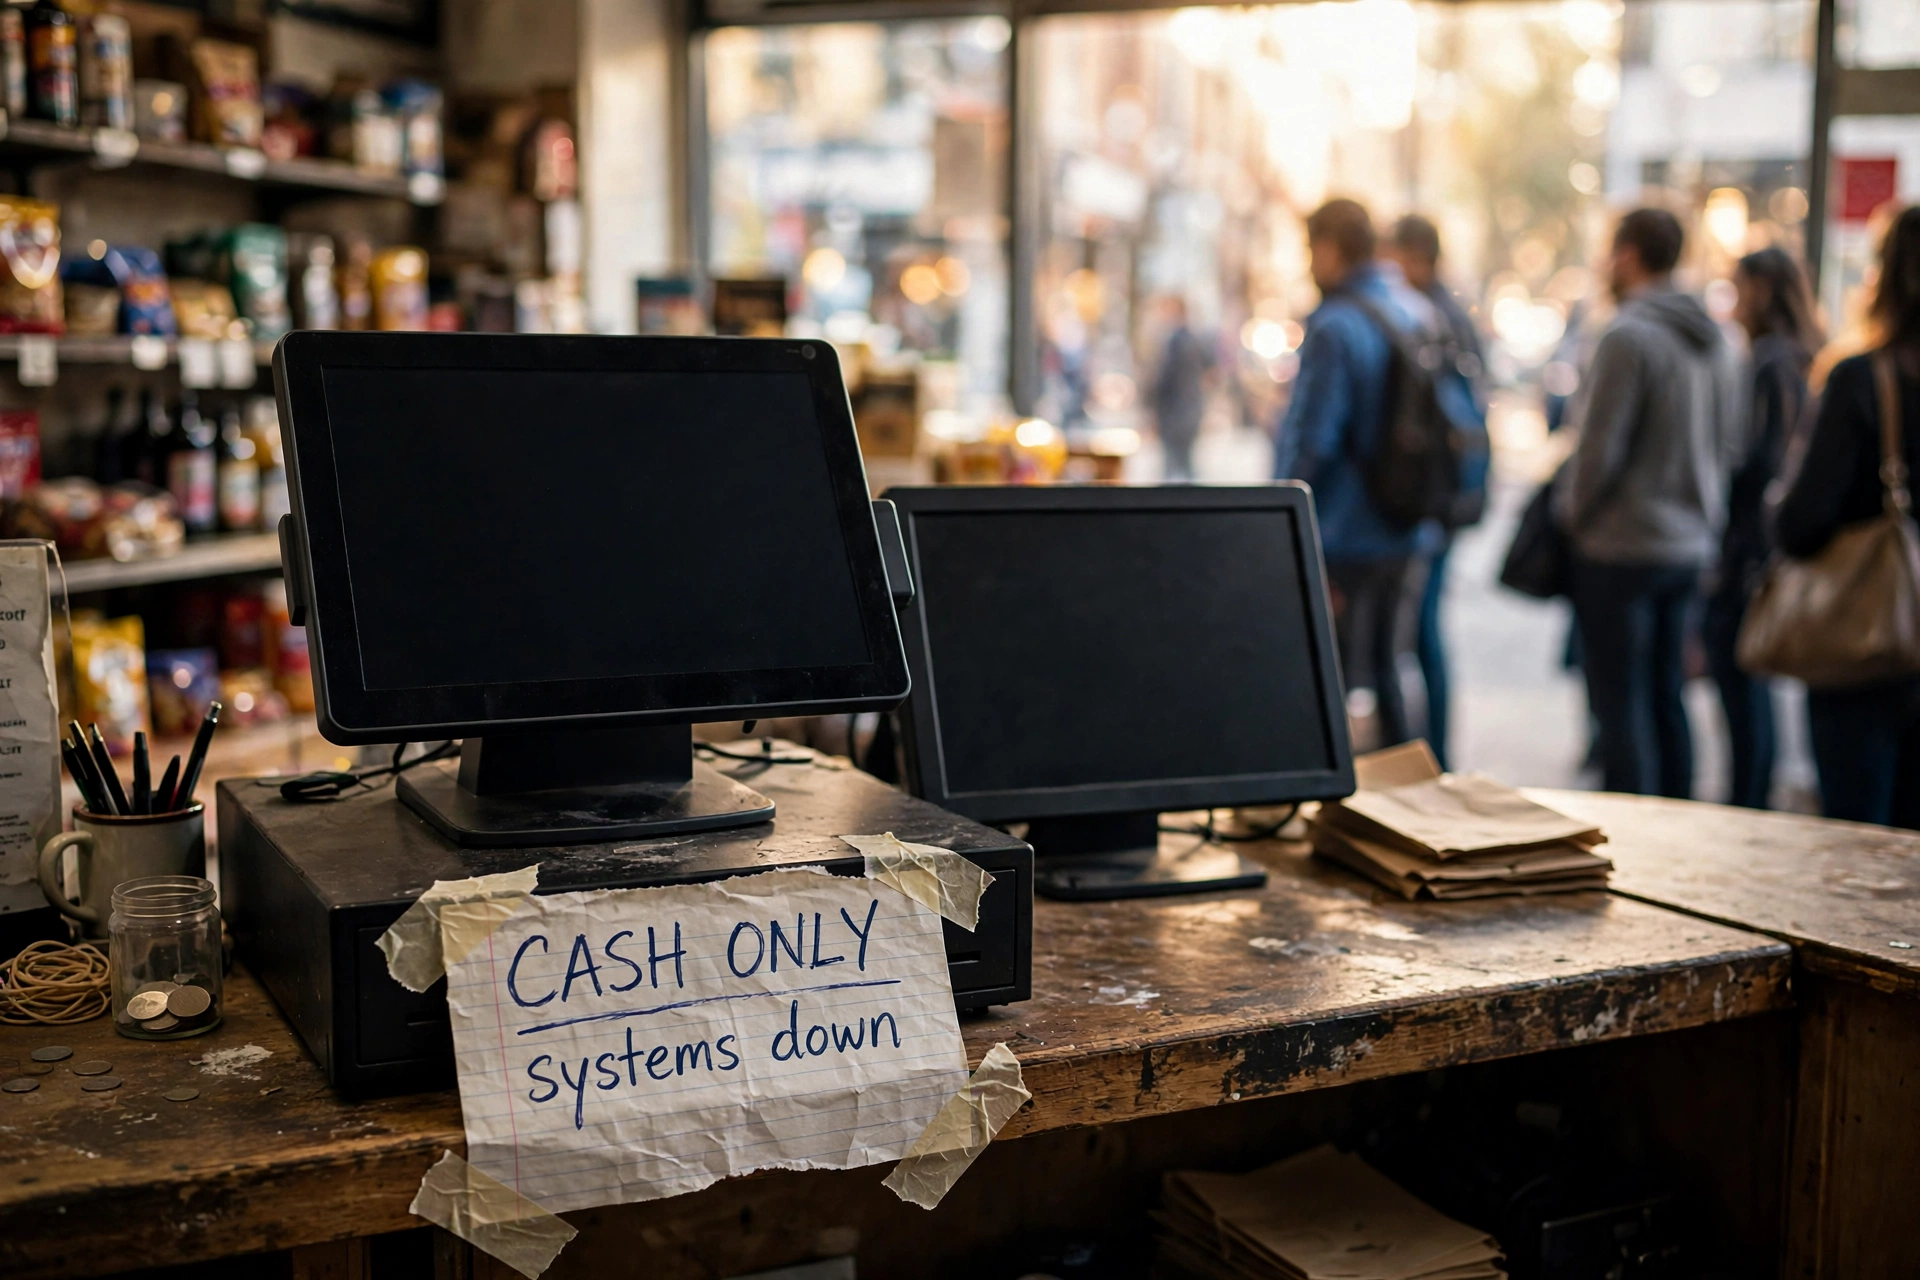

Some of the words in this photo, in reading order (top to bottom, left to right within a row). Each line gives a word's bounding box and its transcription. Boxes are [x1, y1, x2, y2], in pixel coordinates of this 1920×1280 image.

[506, 921, 687, 1008] CASH
[727, 899, 879, 979] ONLY
[527, 1026, 740, 1130] systems
[771, 1000, 901, 1062] down
